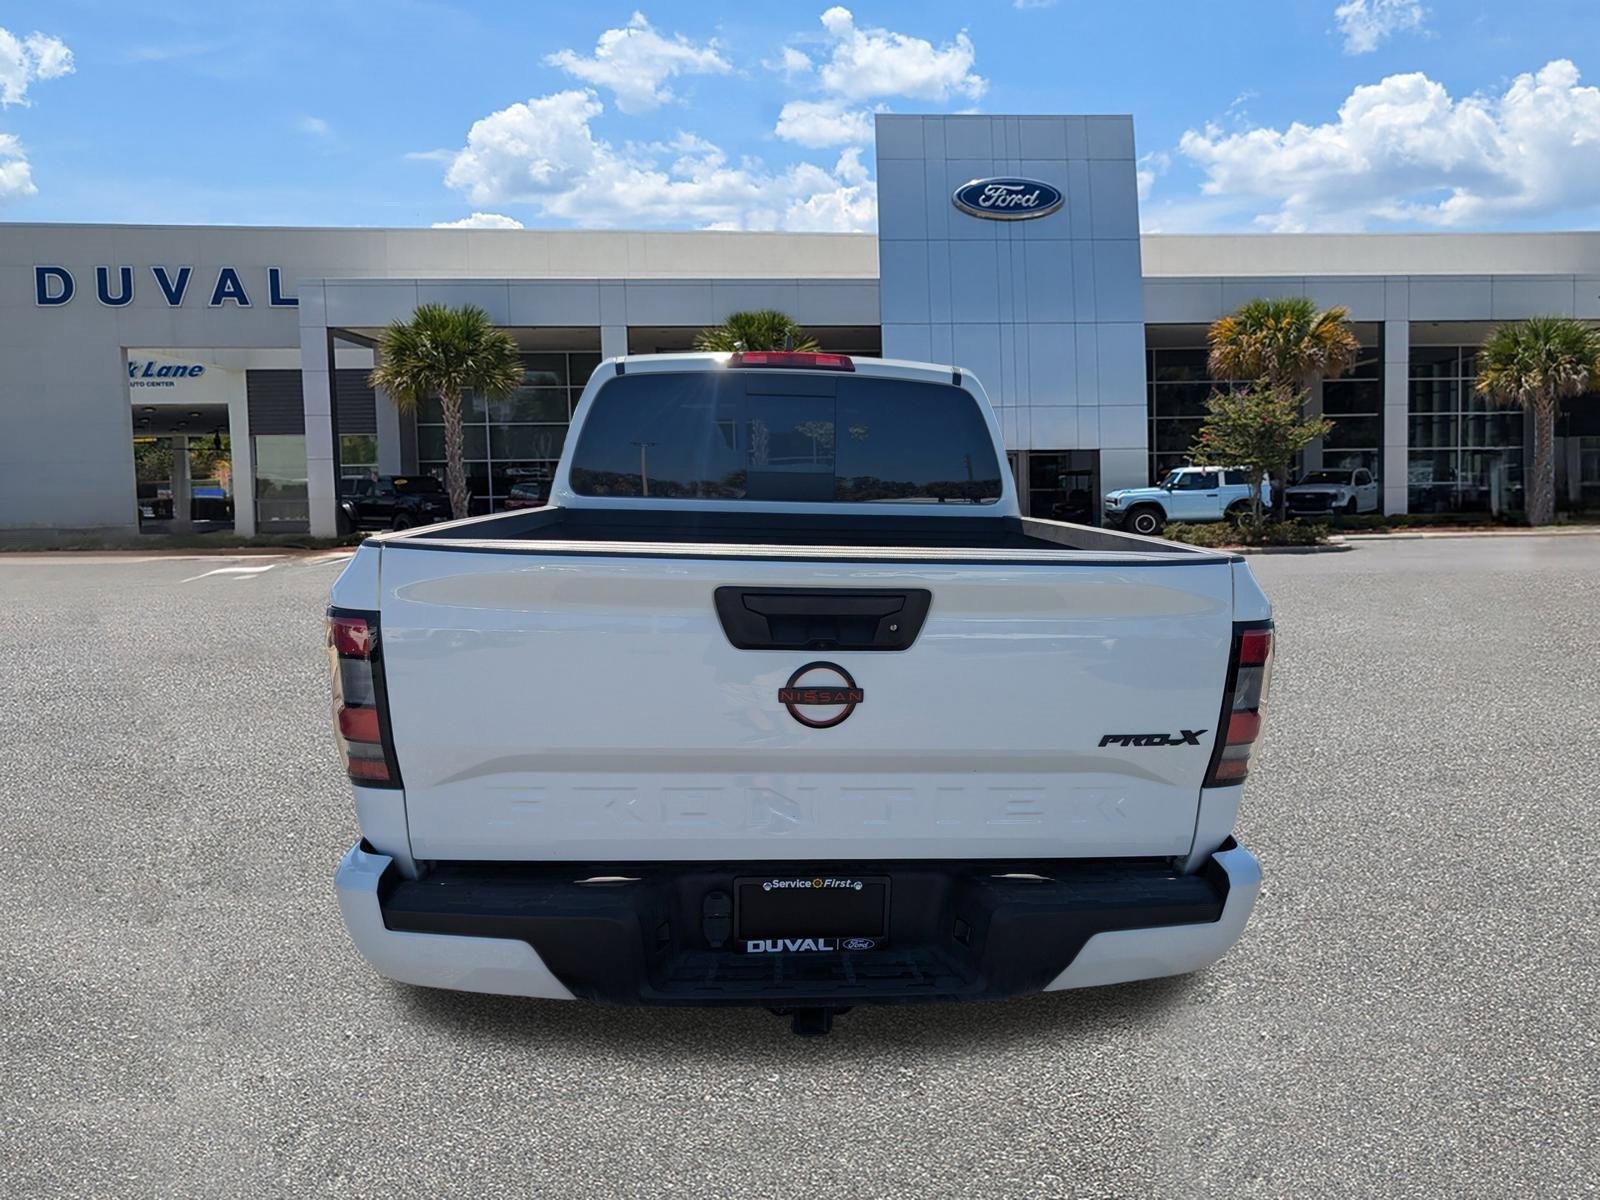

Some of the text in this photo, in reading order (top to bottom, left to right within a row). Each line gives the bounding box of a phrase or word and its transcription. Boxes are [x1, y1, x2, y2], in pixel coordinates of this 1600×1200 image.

[978, 184, 1041, 208] Ford
[33, 264, 299, 307] DUVAL
[141, 361, 205, 378] Lane
[780, 691, 861, 702] NISSAN
[485, 785, 1130, 826] FRONTIER
[772, 879, 812, 889] Service
[747, 938, 834, 953] DUVAL
